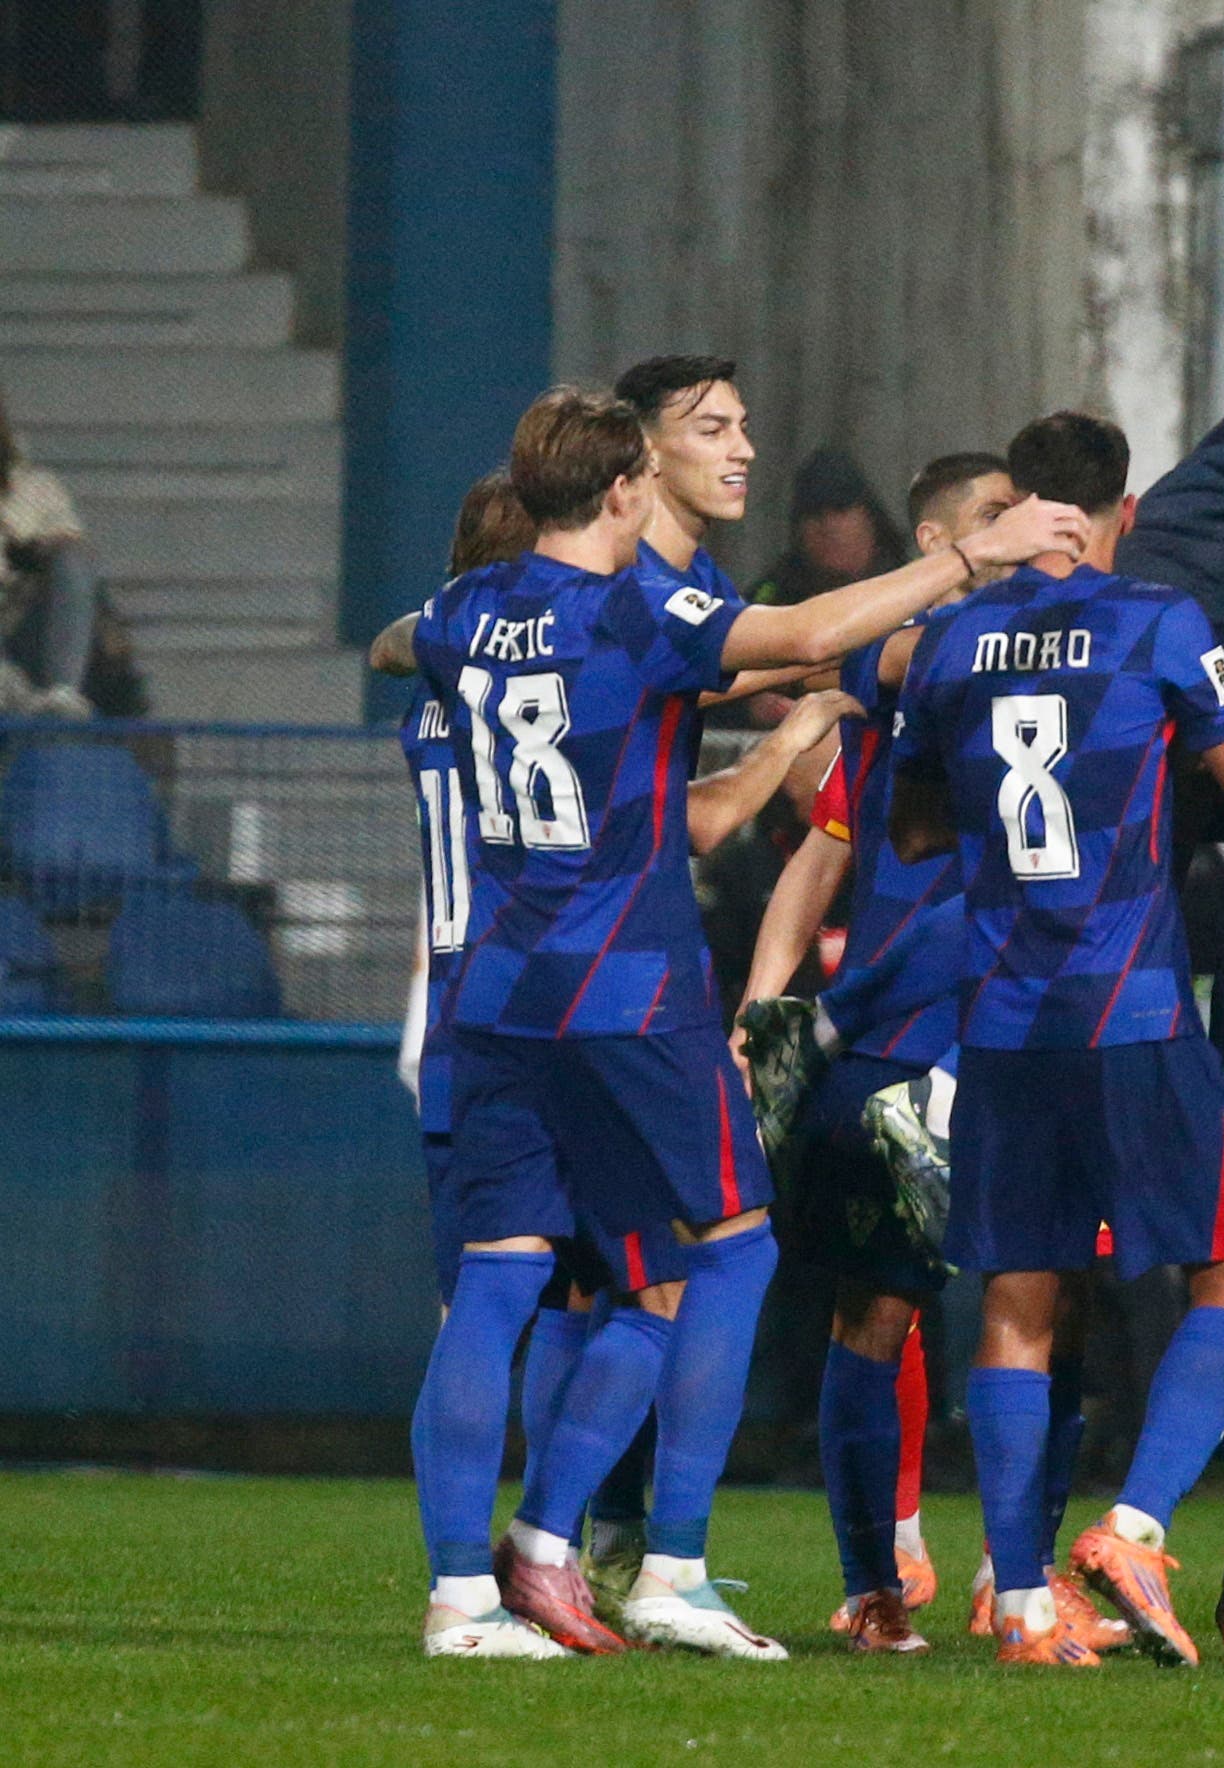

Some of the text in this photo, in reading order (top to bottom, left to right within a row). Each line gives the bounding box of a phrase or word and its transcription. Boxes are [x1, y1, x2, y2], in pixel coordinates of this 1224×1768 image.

[971, 628, 1093, 673] MORO
[457, 665, 591, 850] 18
[992, 693, 1080, 882] 8
